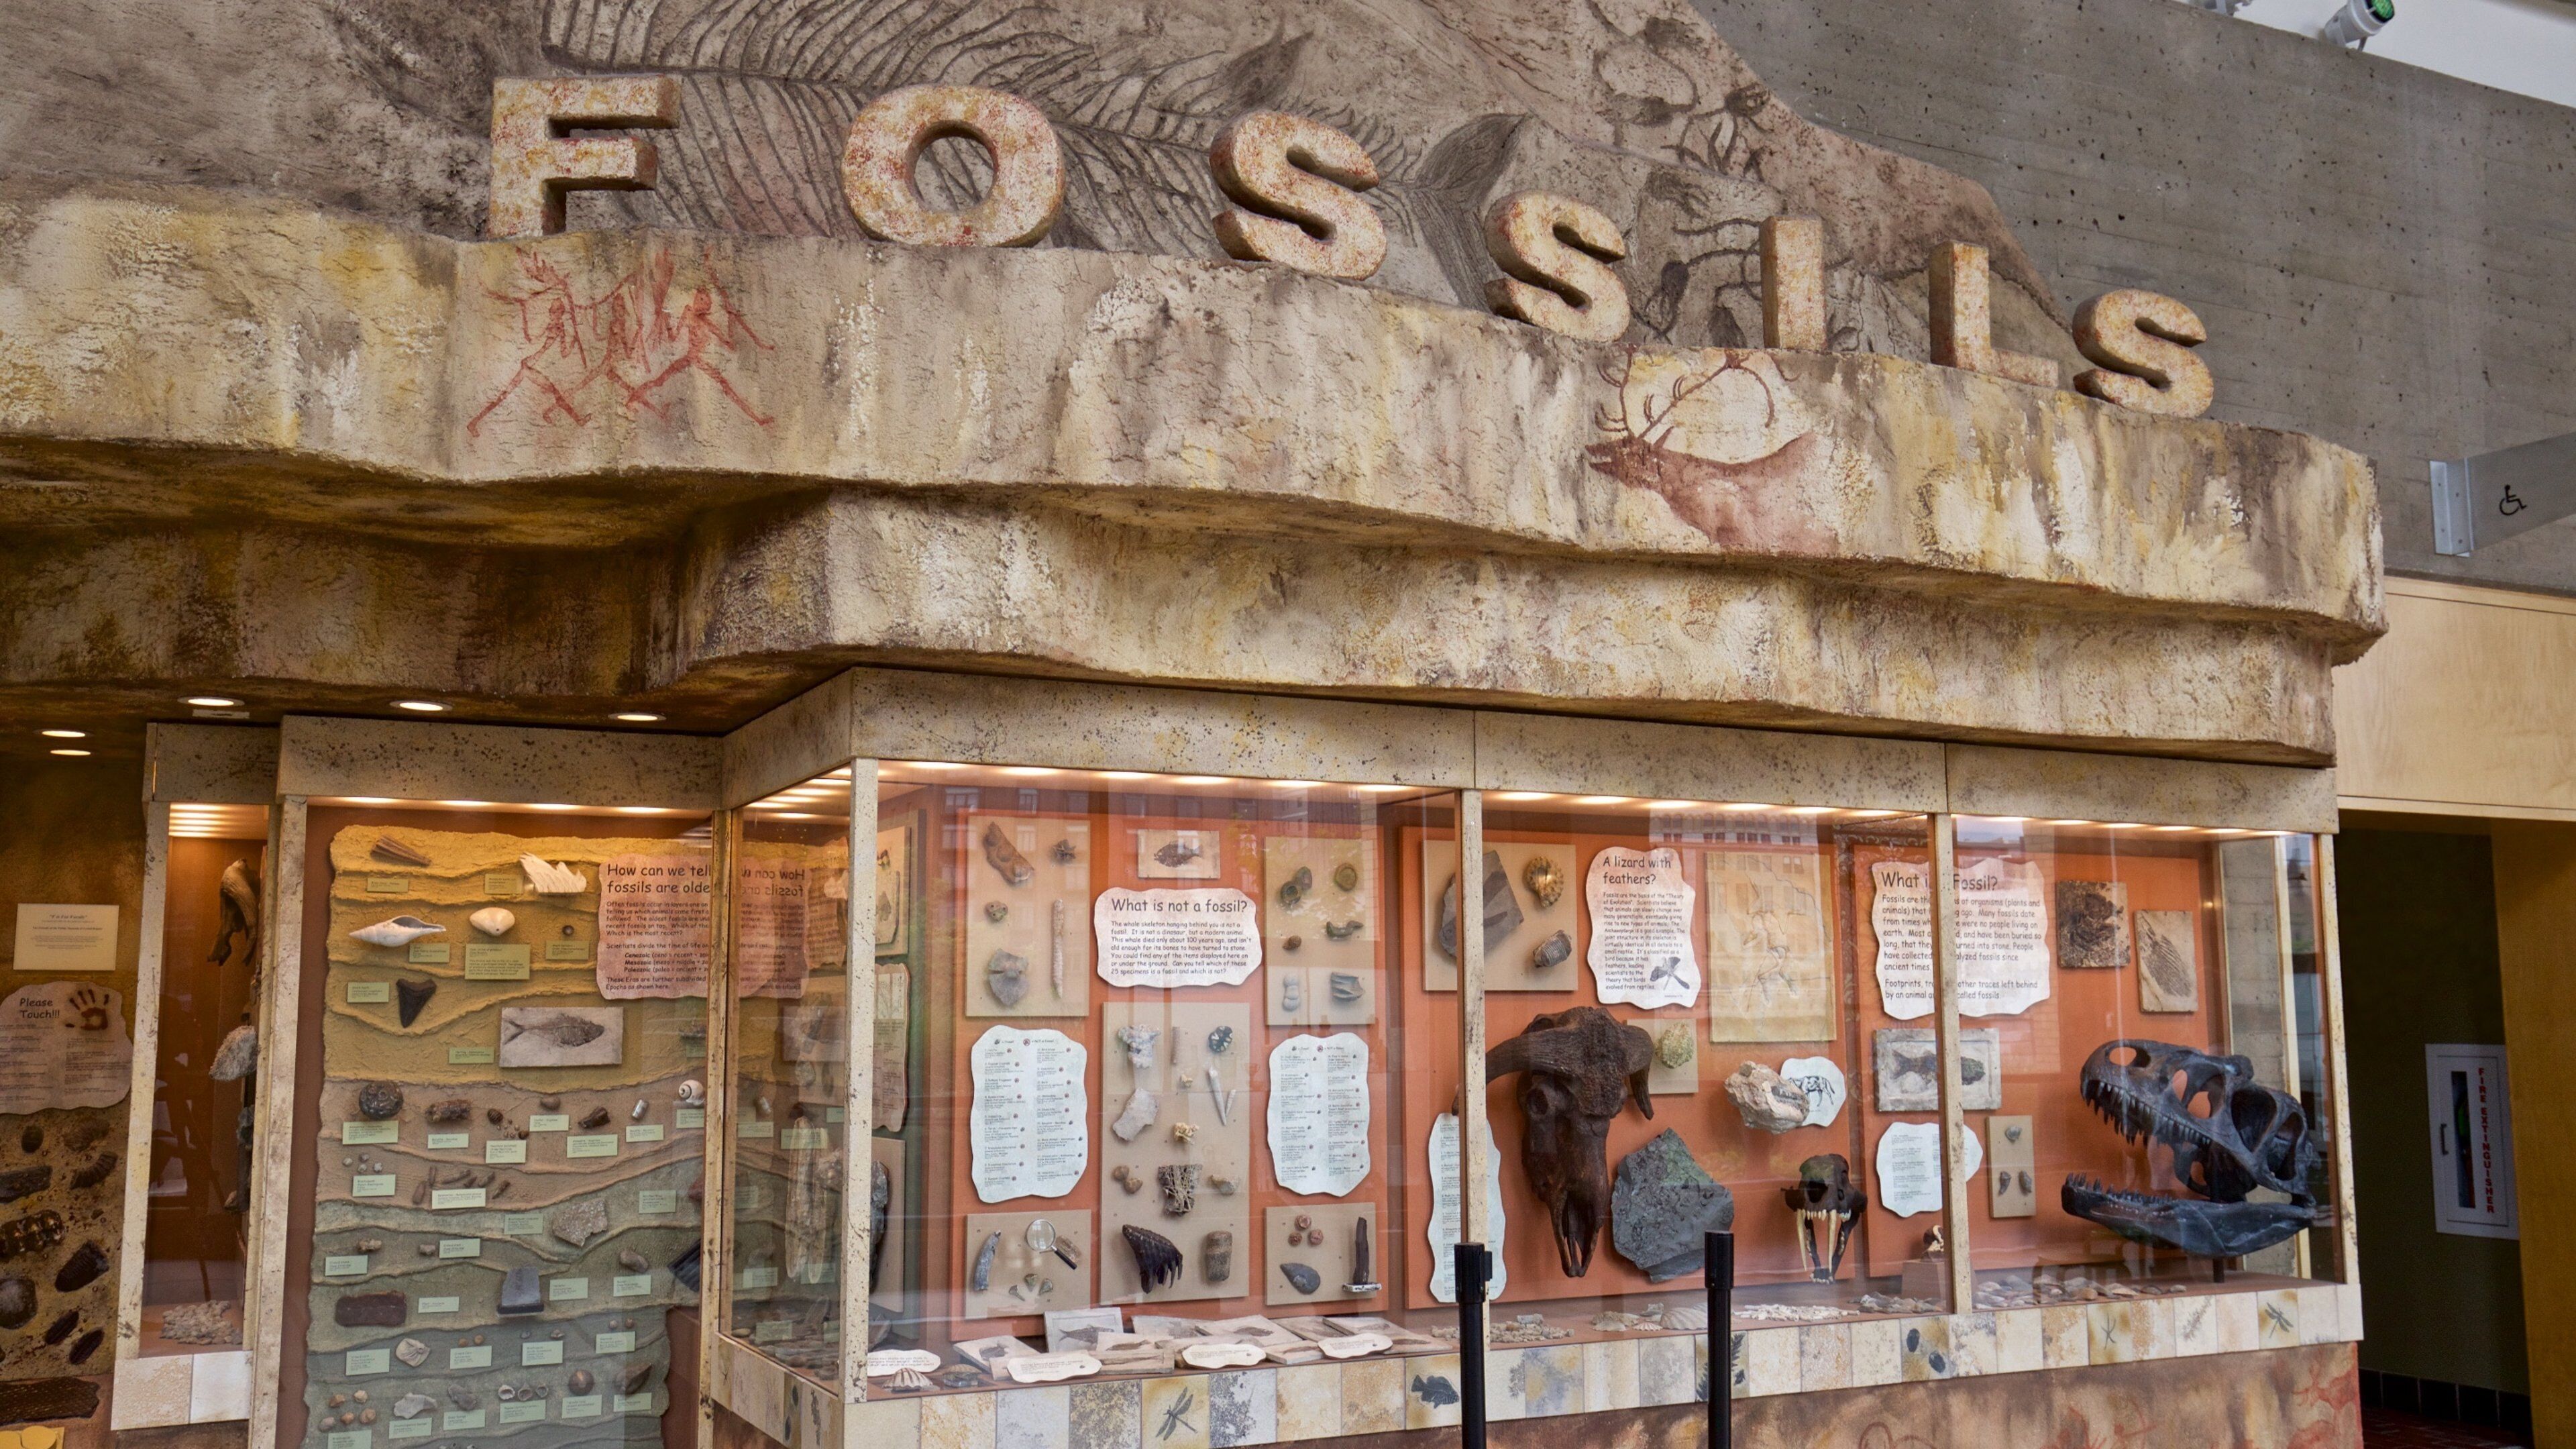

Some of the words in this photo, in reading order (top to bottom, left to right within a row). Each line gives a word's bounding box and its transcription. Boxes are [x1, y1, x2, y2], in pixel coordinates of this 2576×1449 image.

[488, 72, 2214, 417] FOSSILS
[1603, 857, 1610, 867] A
[1615, 857, 1644, 867] lizard
[1649, 857, 1671, 868] with
[608, 864, 636, 876] How
[641, 867, 663, 876] can
[667, 867, 685, 876] we
[1603, 873, 1656, 885] feathers?
[1882, 871, 1919, 888] What
[1953, 874, 1998, 890] Fossil?
[608, 881, 651, 894] fossils
[657, 884, 678, 893] are
[683, 881, 710, 894] olde
[1112, 899, 1148, 912] What
[1154, 900, 1163, 912] is
[1169, 900, 1189, 912] not
[1194, 904, 1201, 912] a
[1206, 900, 1247, 913] fossil?
[1882, 894, 1904, 902] Fossils
[2005, 898, 2027, 907] (plants
[1882, 906, 1910, 915] animals)
[1978, 909, 1994, 918] Many
[1883, 917, 1900, 925] from
[1990, 921, 2010, 929] people
[2012, 920, 2028, 930] living
[1883, 928, 1904, 936] earth.
[1884, 940, 1899, 950] long,
[1902, 940, 1916, 948] that
[2013, 942, 2033, 952] People
[1902, 951, 1932, 959] collected
[1885, 979, 1923, 988] Footprints,
[2017, 980, 2037, 988] behind
[1886, 990, 1894, 1002] by
[20, 998, 53, 1007] Please
[21, 1010, 60, 1019] Touch!!!
[2478, 1067, 2487, 1103] FIRE
[2481, 1108, 2495, 1214] EXTINGUISHER
